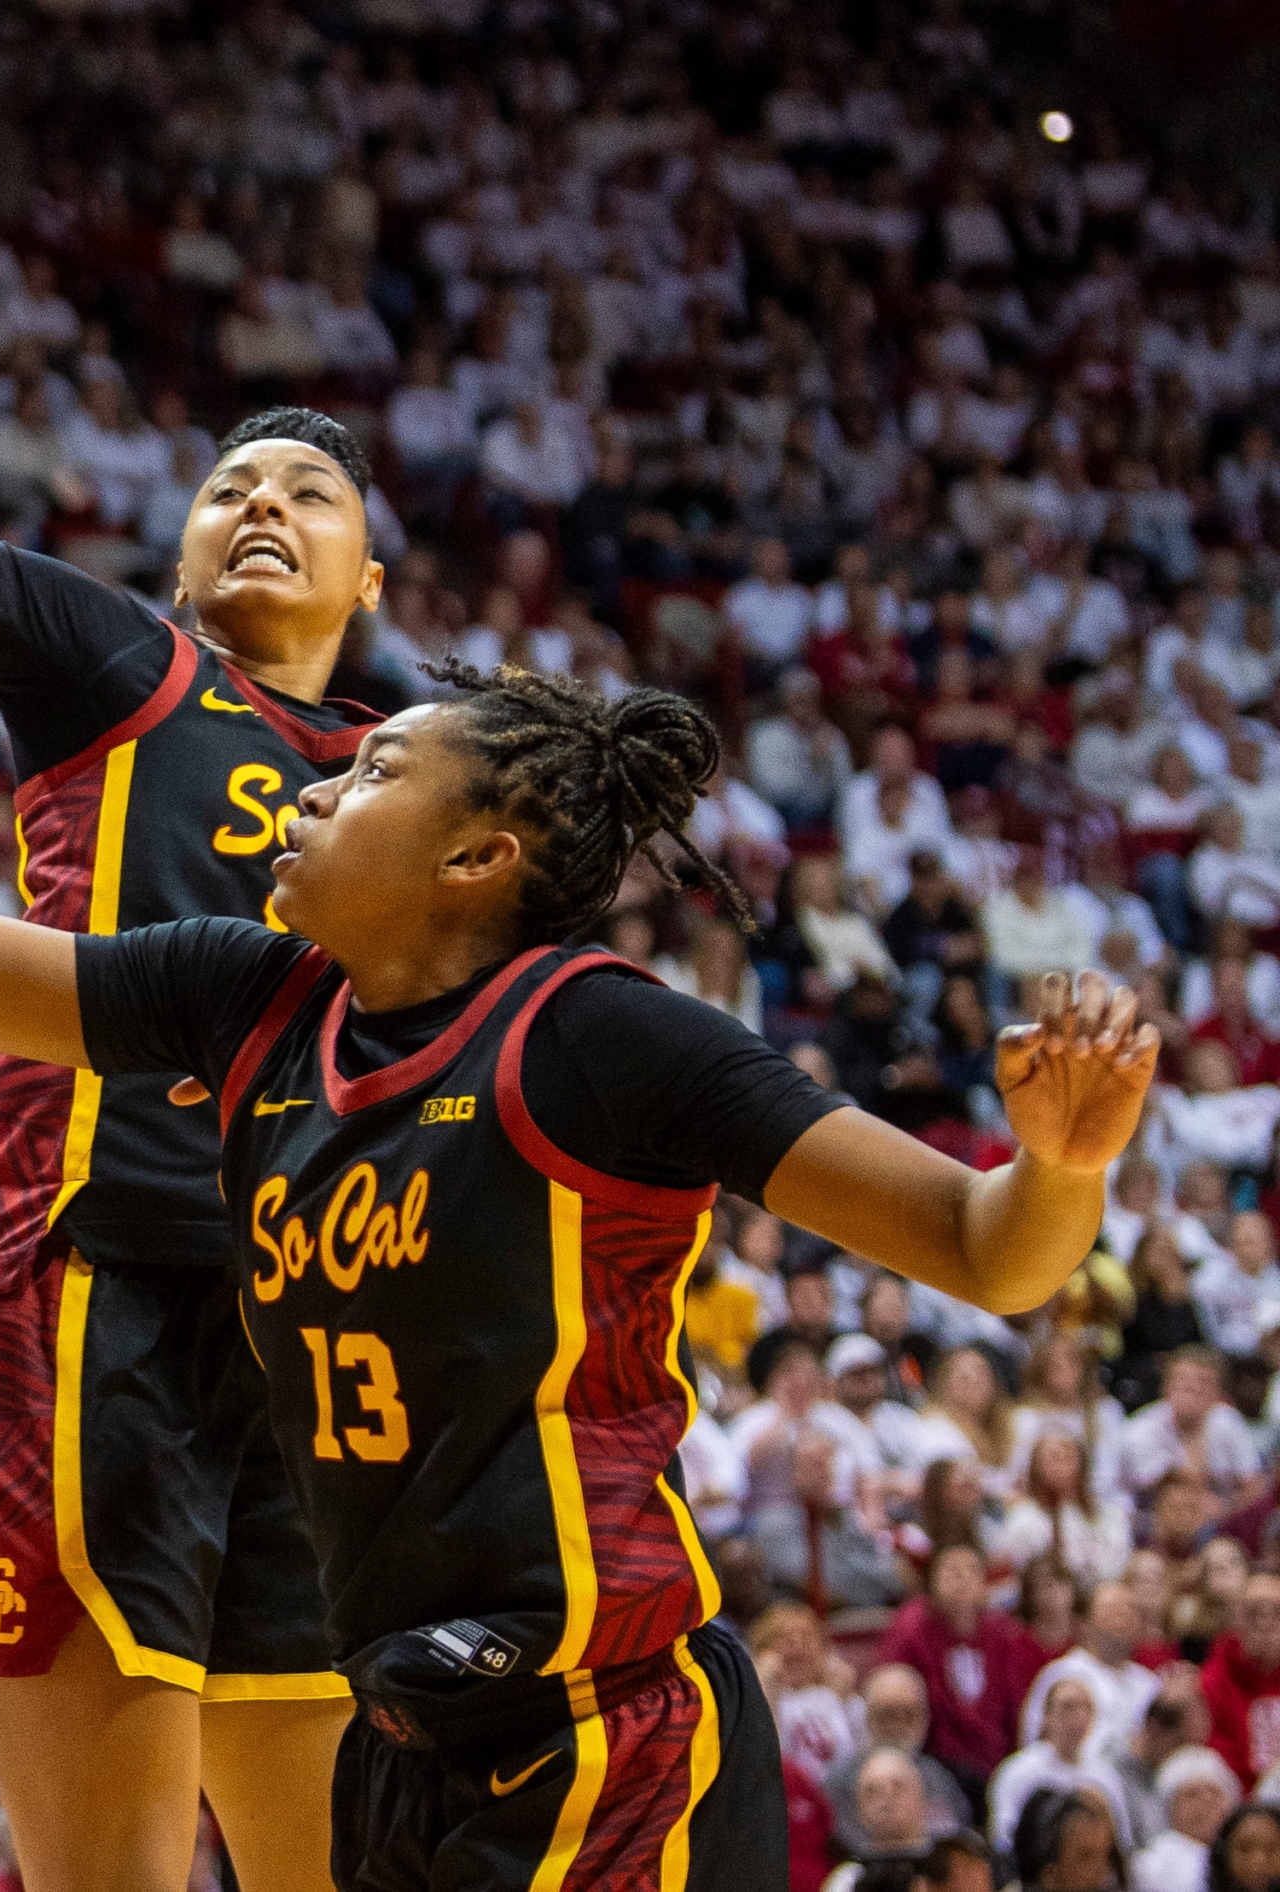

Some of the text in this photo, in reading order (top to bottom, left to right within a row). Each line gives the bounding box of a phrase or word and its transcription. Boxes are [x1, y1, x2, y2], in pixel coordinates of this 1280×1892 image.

[252, 1160, 431, 1305] So Cal
[297, 1325, 412, 1464] 13
[481, 1646, 508, 1669] 48
